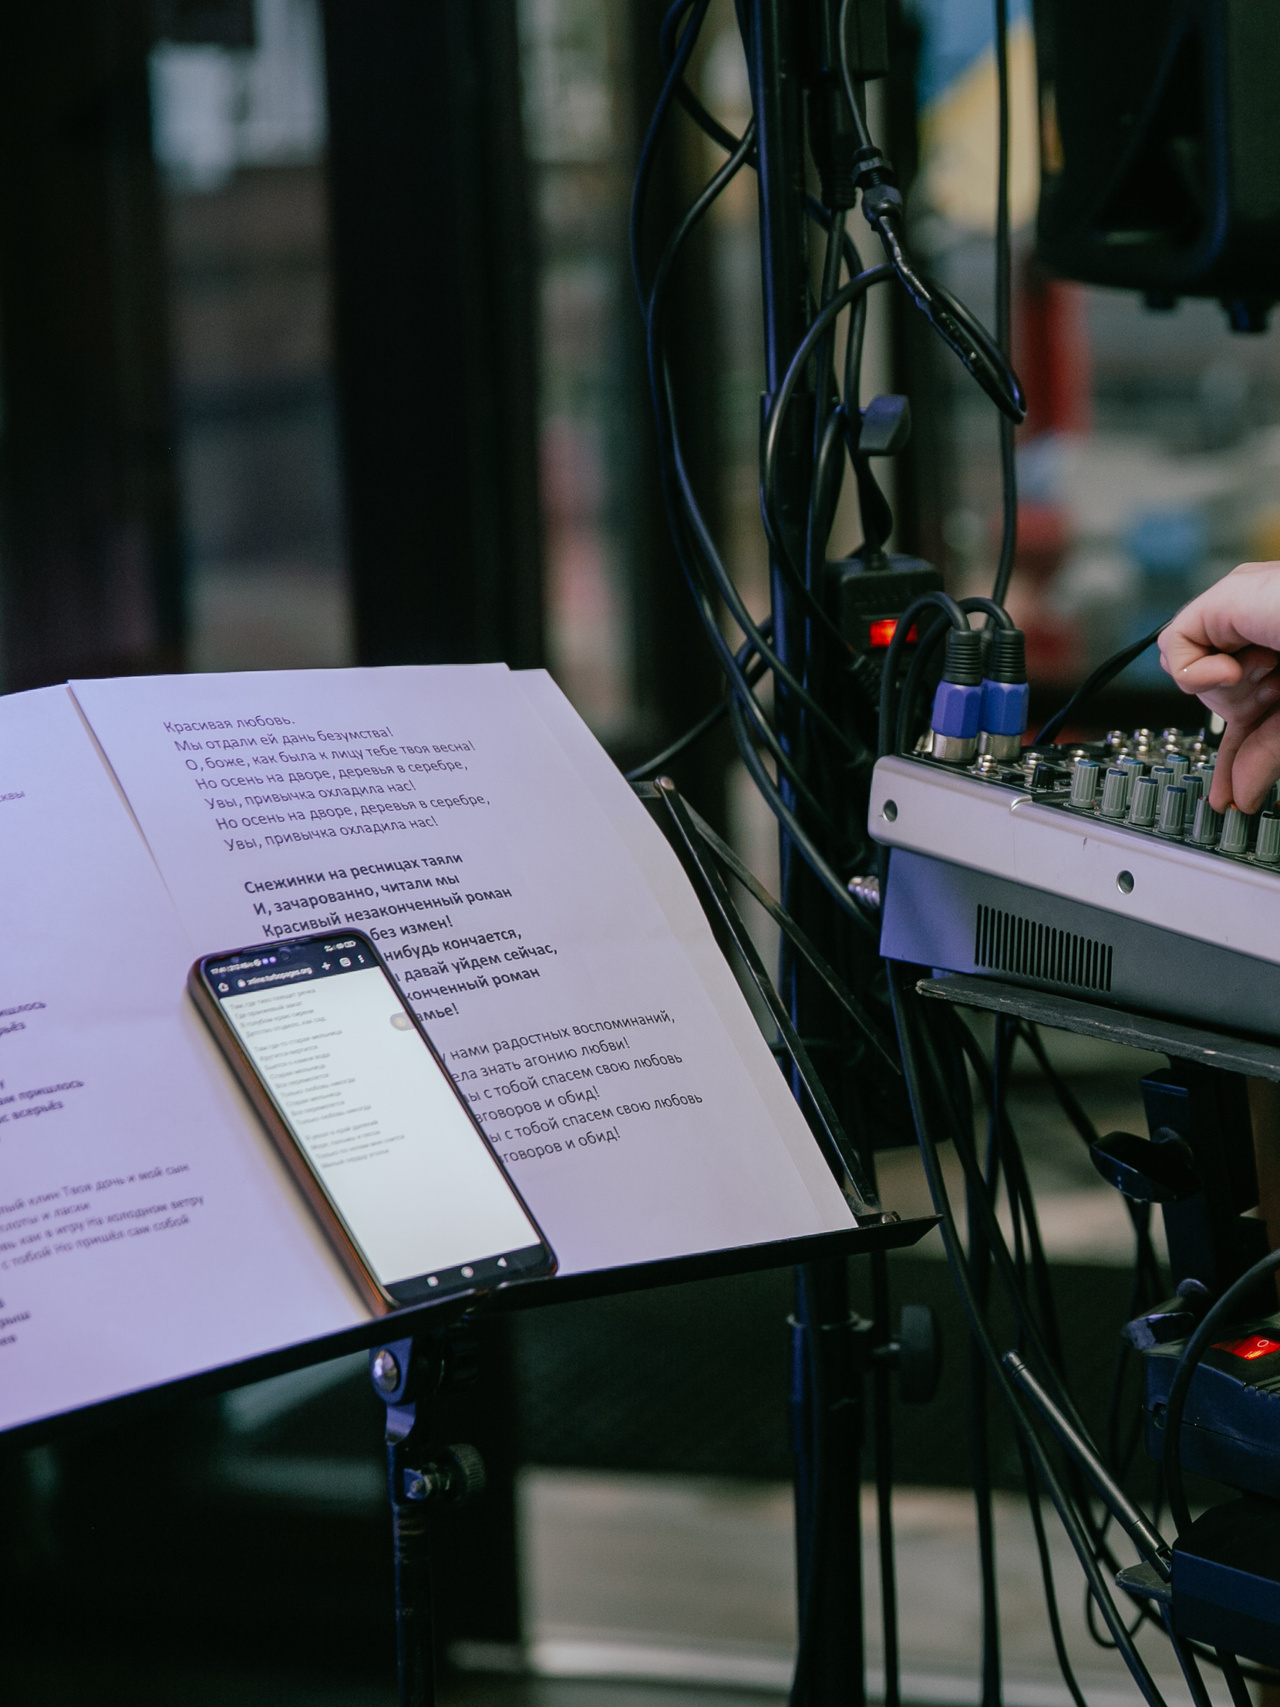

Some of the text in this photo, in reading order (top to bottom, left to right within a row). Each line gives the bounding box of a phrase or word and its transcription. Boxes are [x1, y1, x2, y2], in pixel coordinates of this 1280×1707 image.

[163, 715, 295, 735] Красивая любовь.
[174, 726, 394, 752] Мы отдали ей дань безумства!
[185, 740, 476, 772] О, боже, как была к лицу тебе твоя весна!
[194, 759, 468, 790] Но осень на дворе, деревья в серебре,
[204, 780, 417, 810] Увы, привычка охладила нас!
[215, 794, 490, 830] Но осень на дворе, деревья в серебре,
[223, 815, 439, 852] Увы, привычка охладила нас!
[244, 854, 464, 894] Снежинки на ресницах таяли
[252, 875, 460, 916] И, зачарованно, читали мы
[261, 888, 513, 938] Красивый незаконченный роман
[370, 914, 454, 941] без измен!
[384, 929, 522, 962] нибудь кончается,
[404, 960, 450, 983] давай
[450, 954, 502, 974] уйдем
[503, 944, 558, 962] сейчас,
[491, 968, 541, 988] роман
[449, 1044, 490, 1060] нами
[492, 1027, 571, 1055] радостных
[572, 1009, 675, 1036] воспоминаний,
[480, 1061, 522, 1077] знать
[523, 1048, 578, 1068] агонию
[581, 1036, 630, 1056] любви!
[483, 1089, 493, 1099] с
[493, 1079, 540, 1096] тобой
[541, 1067, 594, 1086] спасем
[595, 1061, 631, 1075] свою
[633, 1053, 683, 1069] любовь
[544, 1098, 555, 1108] и
[557, 1085, 600, 1106] обид!
[504, 1130, 514, 1140] с
[514, 1120, 560, 1137] тобой
[562, 1108, 614, 1127] спасем
[616, 1101, 651, 1116] свою
[654, 1093, 703, 1109] любовь
[564, 1139, 576, 1150] и
[578, 1126, 621, 1147] обид!
